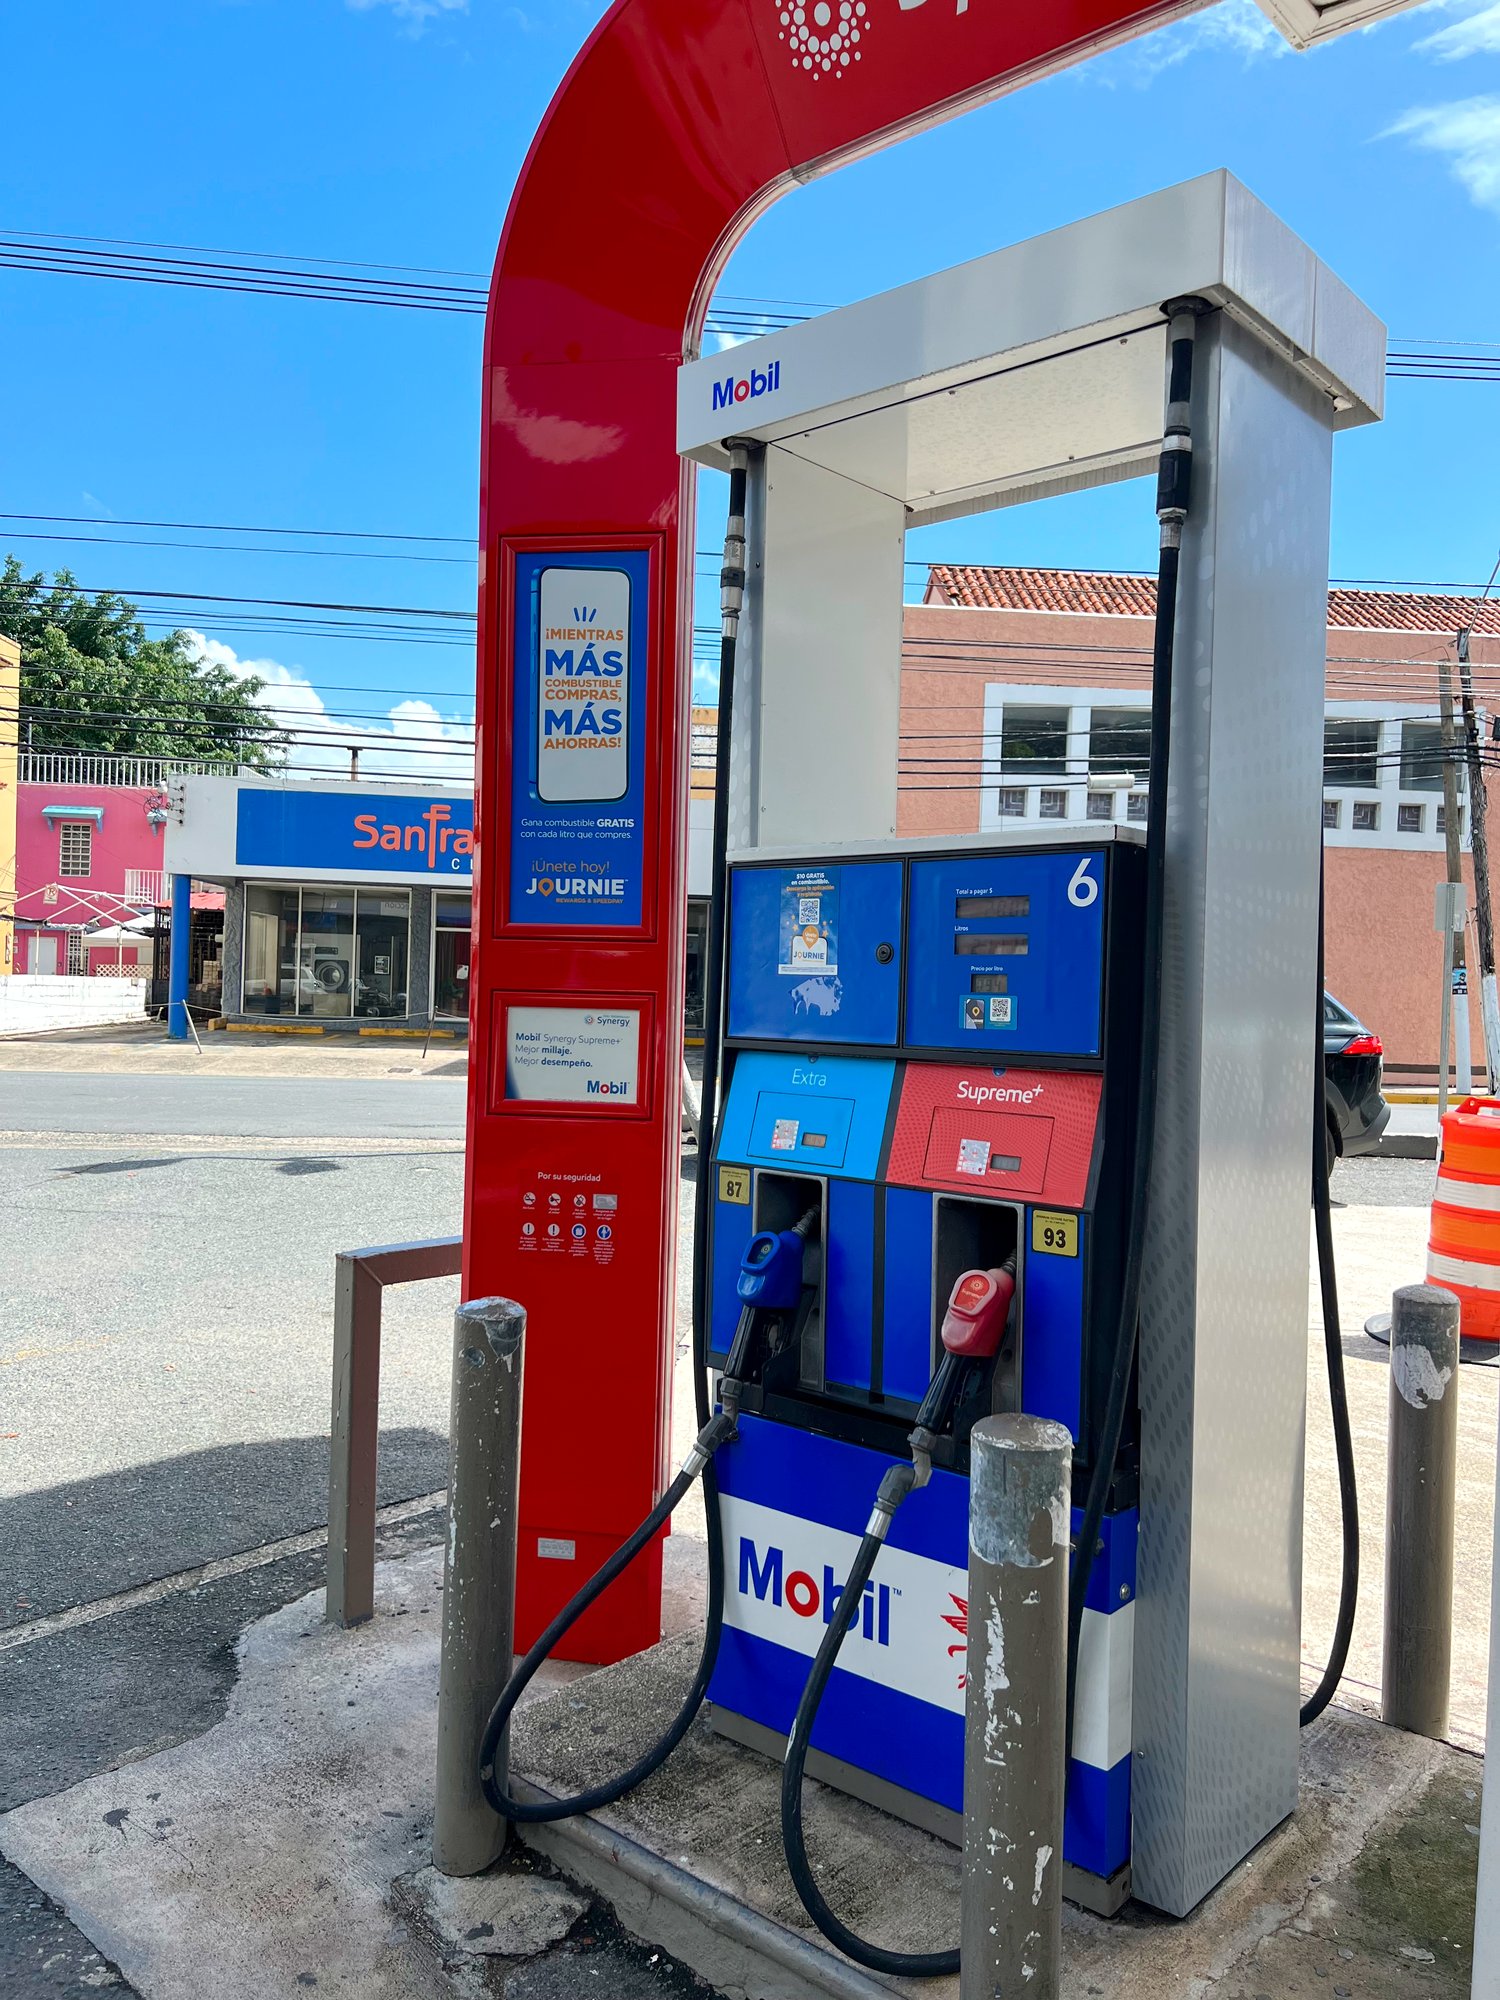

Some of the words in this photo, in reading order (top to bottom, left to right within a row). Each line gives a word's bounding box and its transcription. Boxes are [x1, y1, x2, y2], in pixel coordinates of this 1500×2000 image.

[712, 360, 780, 411] Mobil
[545, 628, 624, 641] ¡MIENTRAS
[545, 642, 624, 677] MÁS
[544, 678, 622, 688] COMBUSTIBLE
[544, 689, 622, 702] COMPRAS,
[544, 701, 623, 735] MÁS
[543, 737, 622, 750] AHORRAS!
[521, 818, 542, 827] Gana
[544, 818, 595, 827] combustible
[596, 818, 635, 828] GRATIS
[537, 830, 558, 838] cada
[559, 830, 576, 838] litro
[577, 831, 593, 840] que
[594, 831, 633, 840] compres.
[531, 857, 577, 873] ¡Únete
[580, 860, 610, 875] hoy!
[525, 877, 625, 897] JOURNIE
[1067, 857, 1099, 908] 6
[793, 951, 825, 960] JOURNIE
[597, 1016, 630, 1027] Synergy
[515, 1032, 541, 1042] Mobil
[543, 1033, 577, 1046] Synergy
[578, 1035, 621, 1046] Supreme+
[515, 1045, 540, 1056] Mejor
[541, 1046, 573, 1056] millaje.
[514, 1056, 539, 1067] Mejor
[541, 1057, 593, 1068] desempeño.
[791, 1068, 827, 1087] Extra
[586, 1080, 628, 1095] Mobil
[956, 1080, 1044, 1105] Supreme+
[537, 1171, 551, 1180] Por
[563, 1173, 602, 1183] seguridad
[726, 1180, 743, 1198] 87
[1043, 1227, 1067, 1249] 93
[738, 1536, 890, 1647] Mobil
